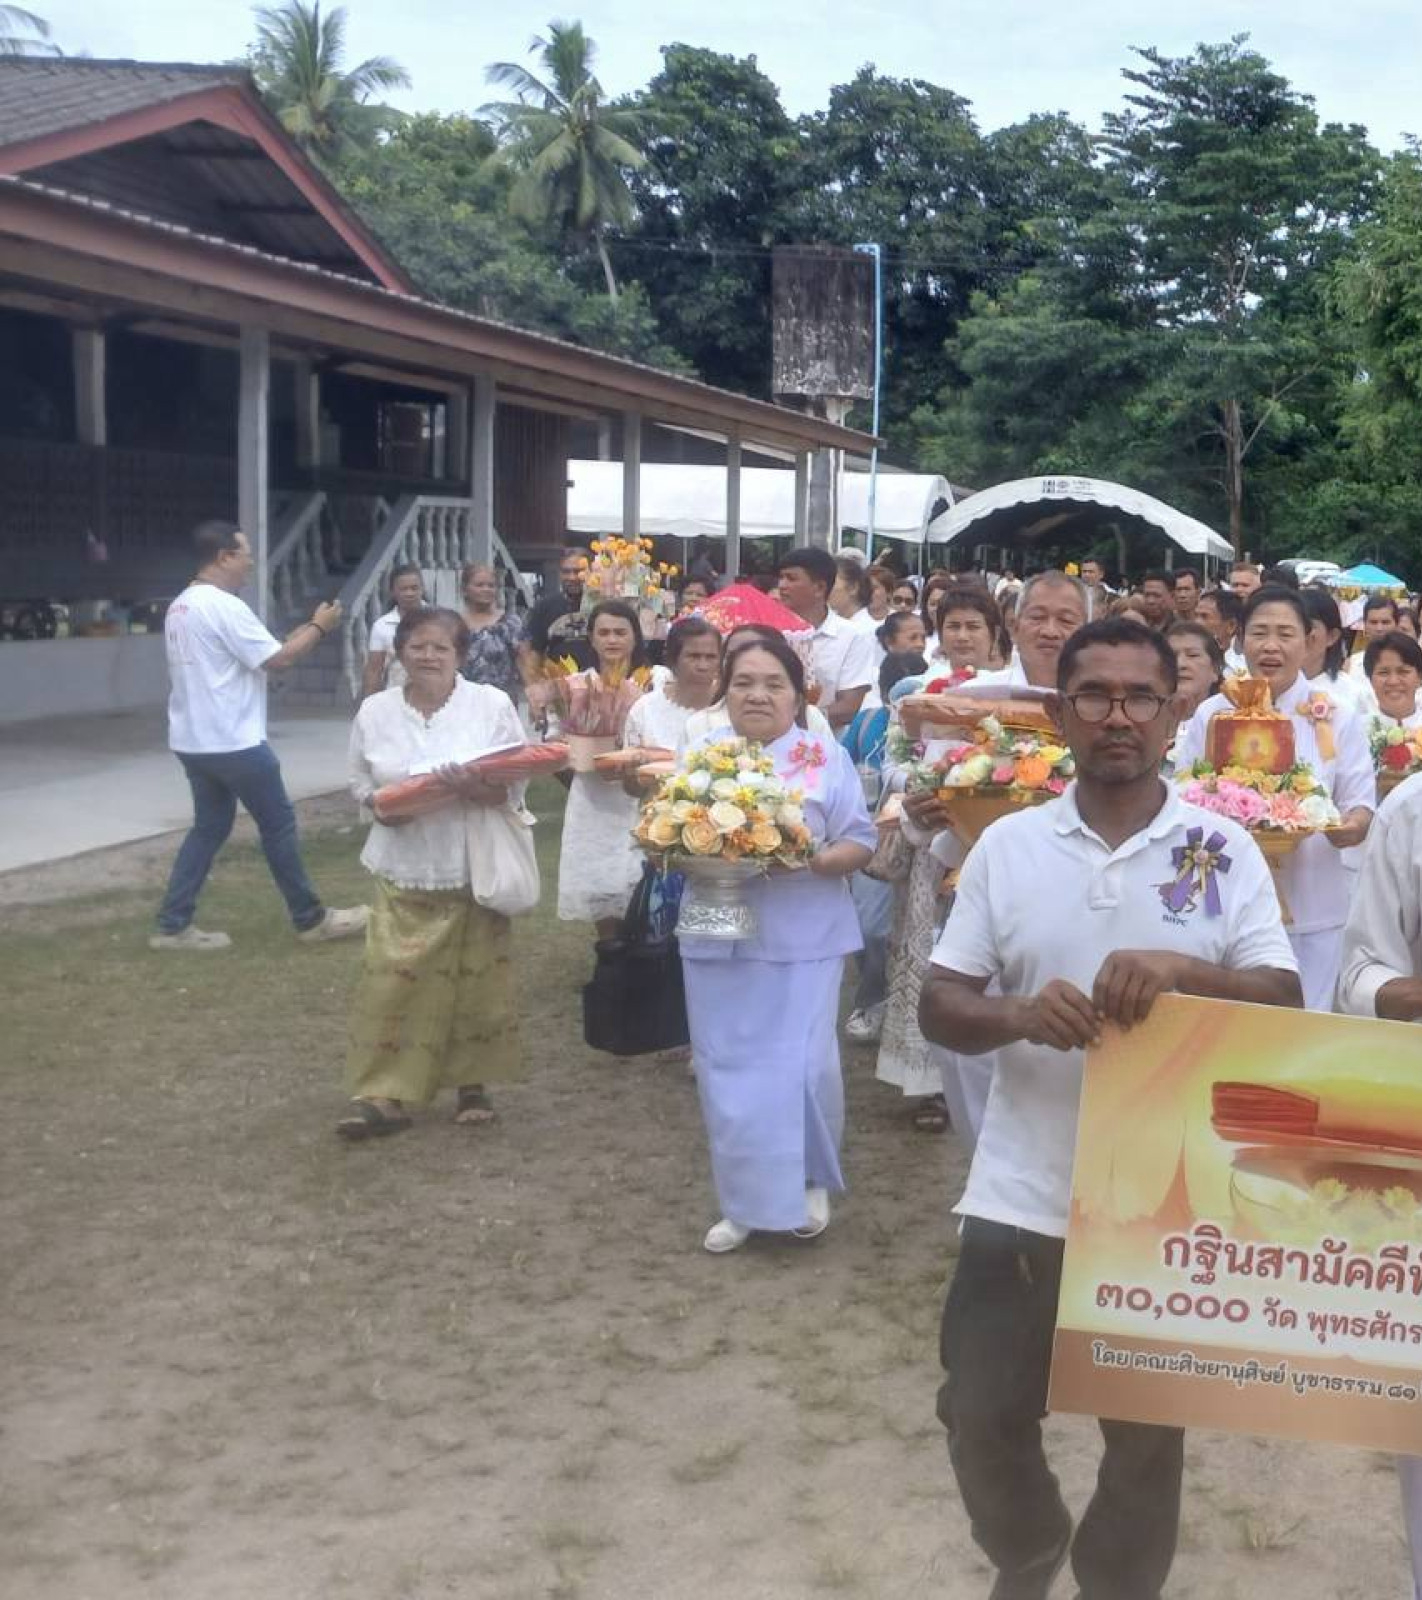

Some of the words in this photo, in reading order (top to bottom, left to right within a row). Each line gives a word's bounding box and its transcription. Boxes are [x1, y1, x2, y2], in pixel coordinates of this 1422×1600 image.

[1096, 1283, 1250, 1323] ๓๐,๐๐๐
[1262, 1296, 1298, 1329] วัด
[1093, 1342, 1130, 1366] โดย
[1134, 1351, 1286, 1387] คณะศิษยานุศิษย์
[1292, 1373, 1383, 1394] บูชาธรรม
[1388, 1384, 1416, 1400] ๘๑
